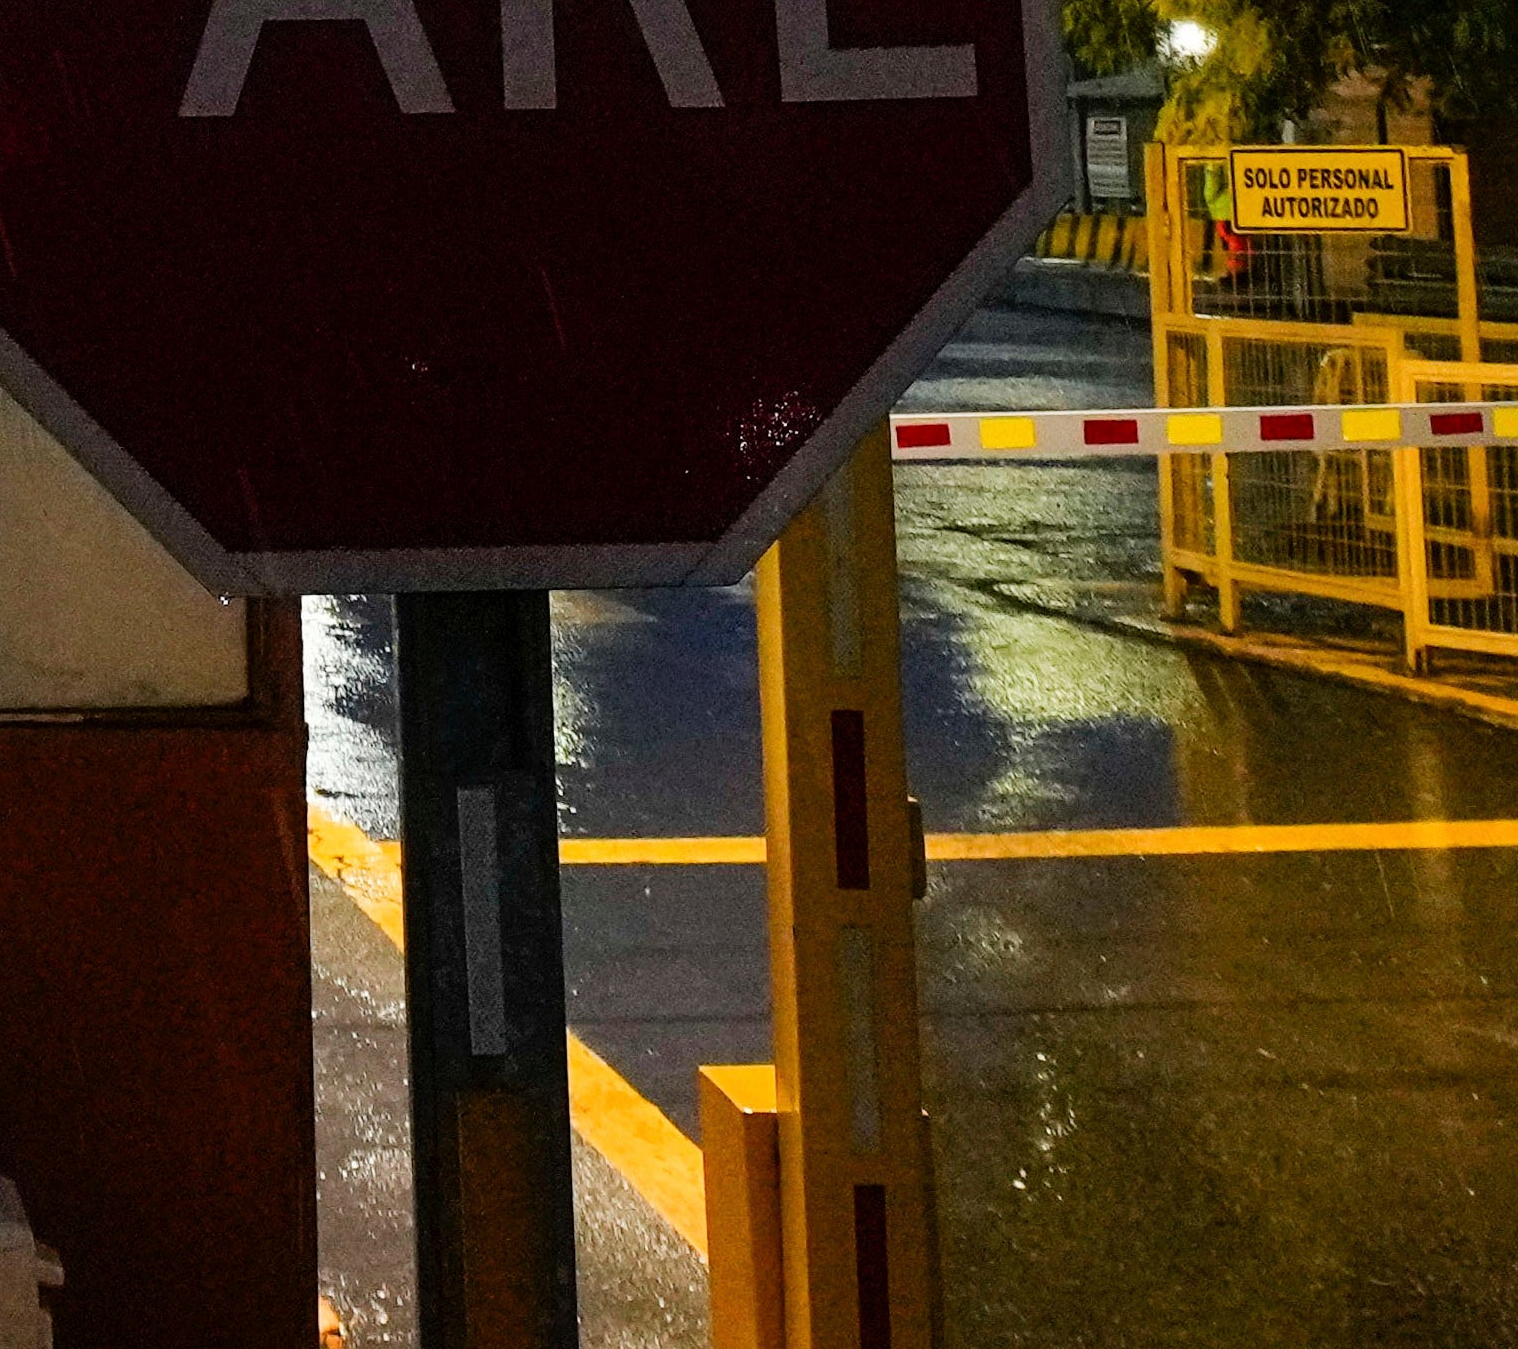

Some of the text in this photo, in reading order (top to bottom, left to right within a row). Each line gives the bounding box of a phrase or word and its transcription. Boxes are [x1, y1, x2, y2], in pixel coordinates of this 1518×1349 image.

[1244, 168, 1393, 189] SOLO PERSONAL
[1262, 197, 1379, 218] AUTORIZADO
